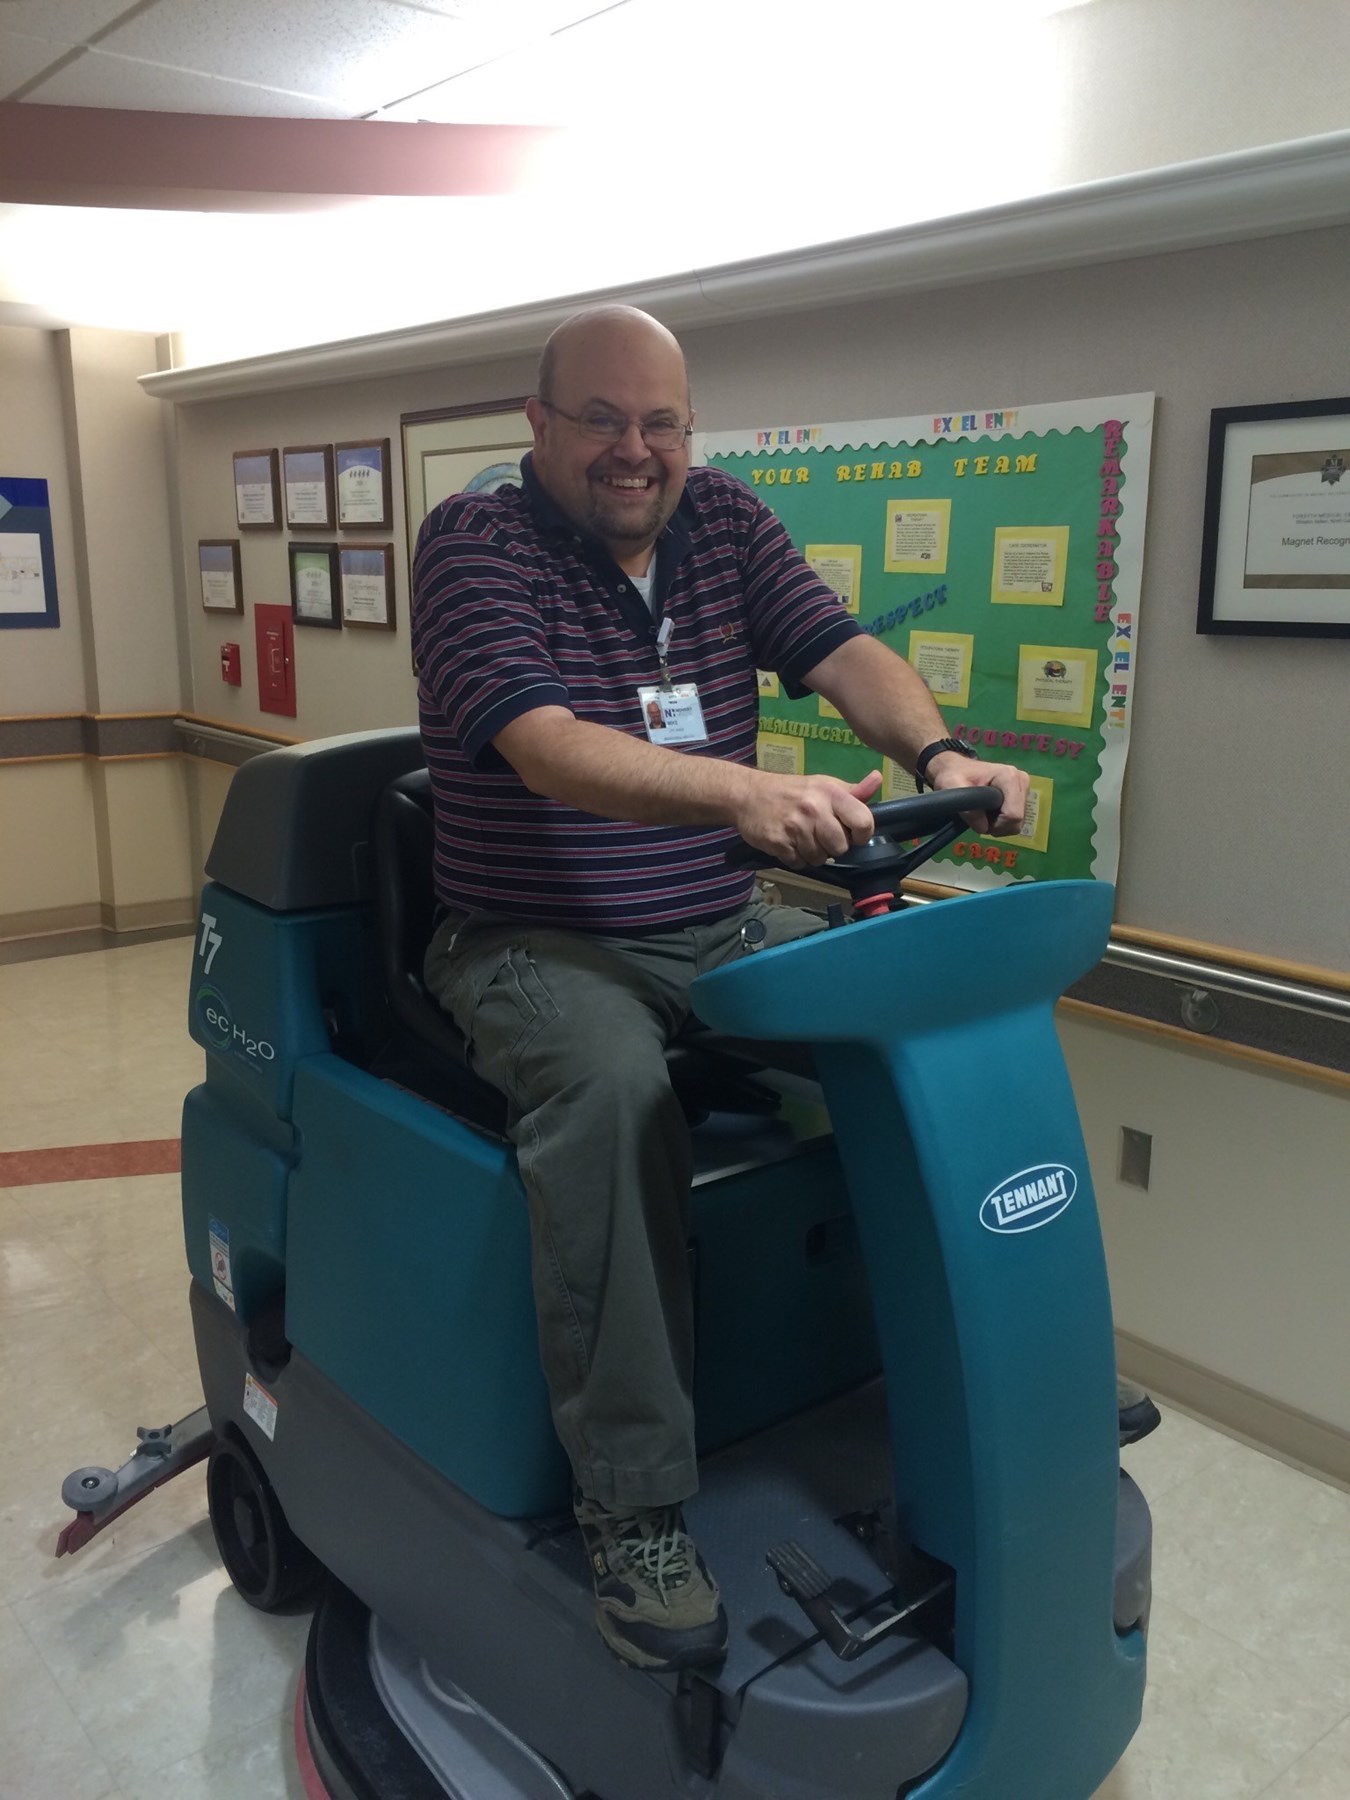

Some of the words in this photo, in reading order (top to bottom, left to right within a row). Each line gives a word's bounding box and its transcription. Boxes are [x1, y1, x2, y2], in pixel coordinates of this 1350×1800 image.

[751, 466, 810, 485] YOUR
[836, 459, 923, 482] REHAB
[953, 453, 1038, 477] TEAM
[1094, 419, 1122, 623] REMARKABLE
[1281, 536, 1314, 547] Magnet
[863, 583, 948, 636] RESPECT
[953, 723, 1087, 760] COURTESY
[952, 841, 1020, 868] CARE
[198, 912, 223, 975] T7
[990, 1170, 1068, 1226] TENNANT
